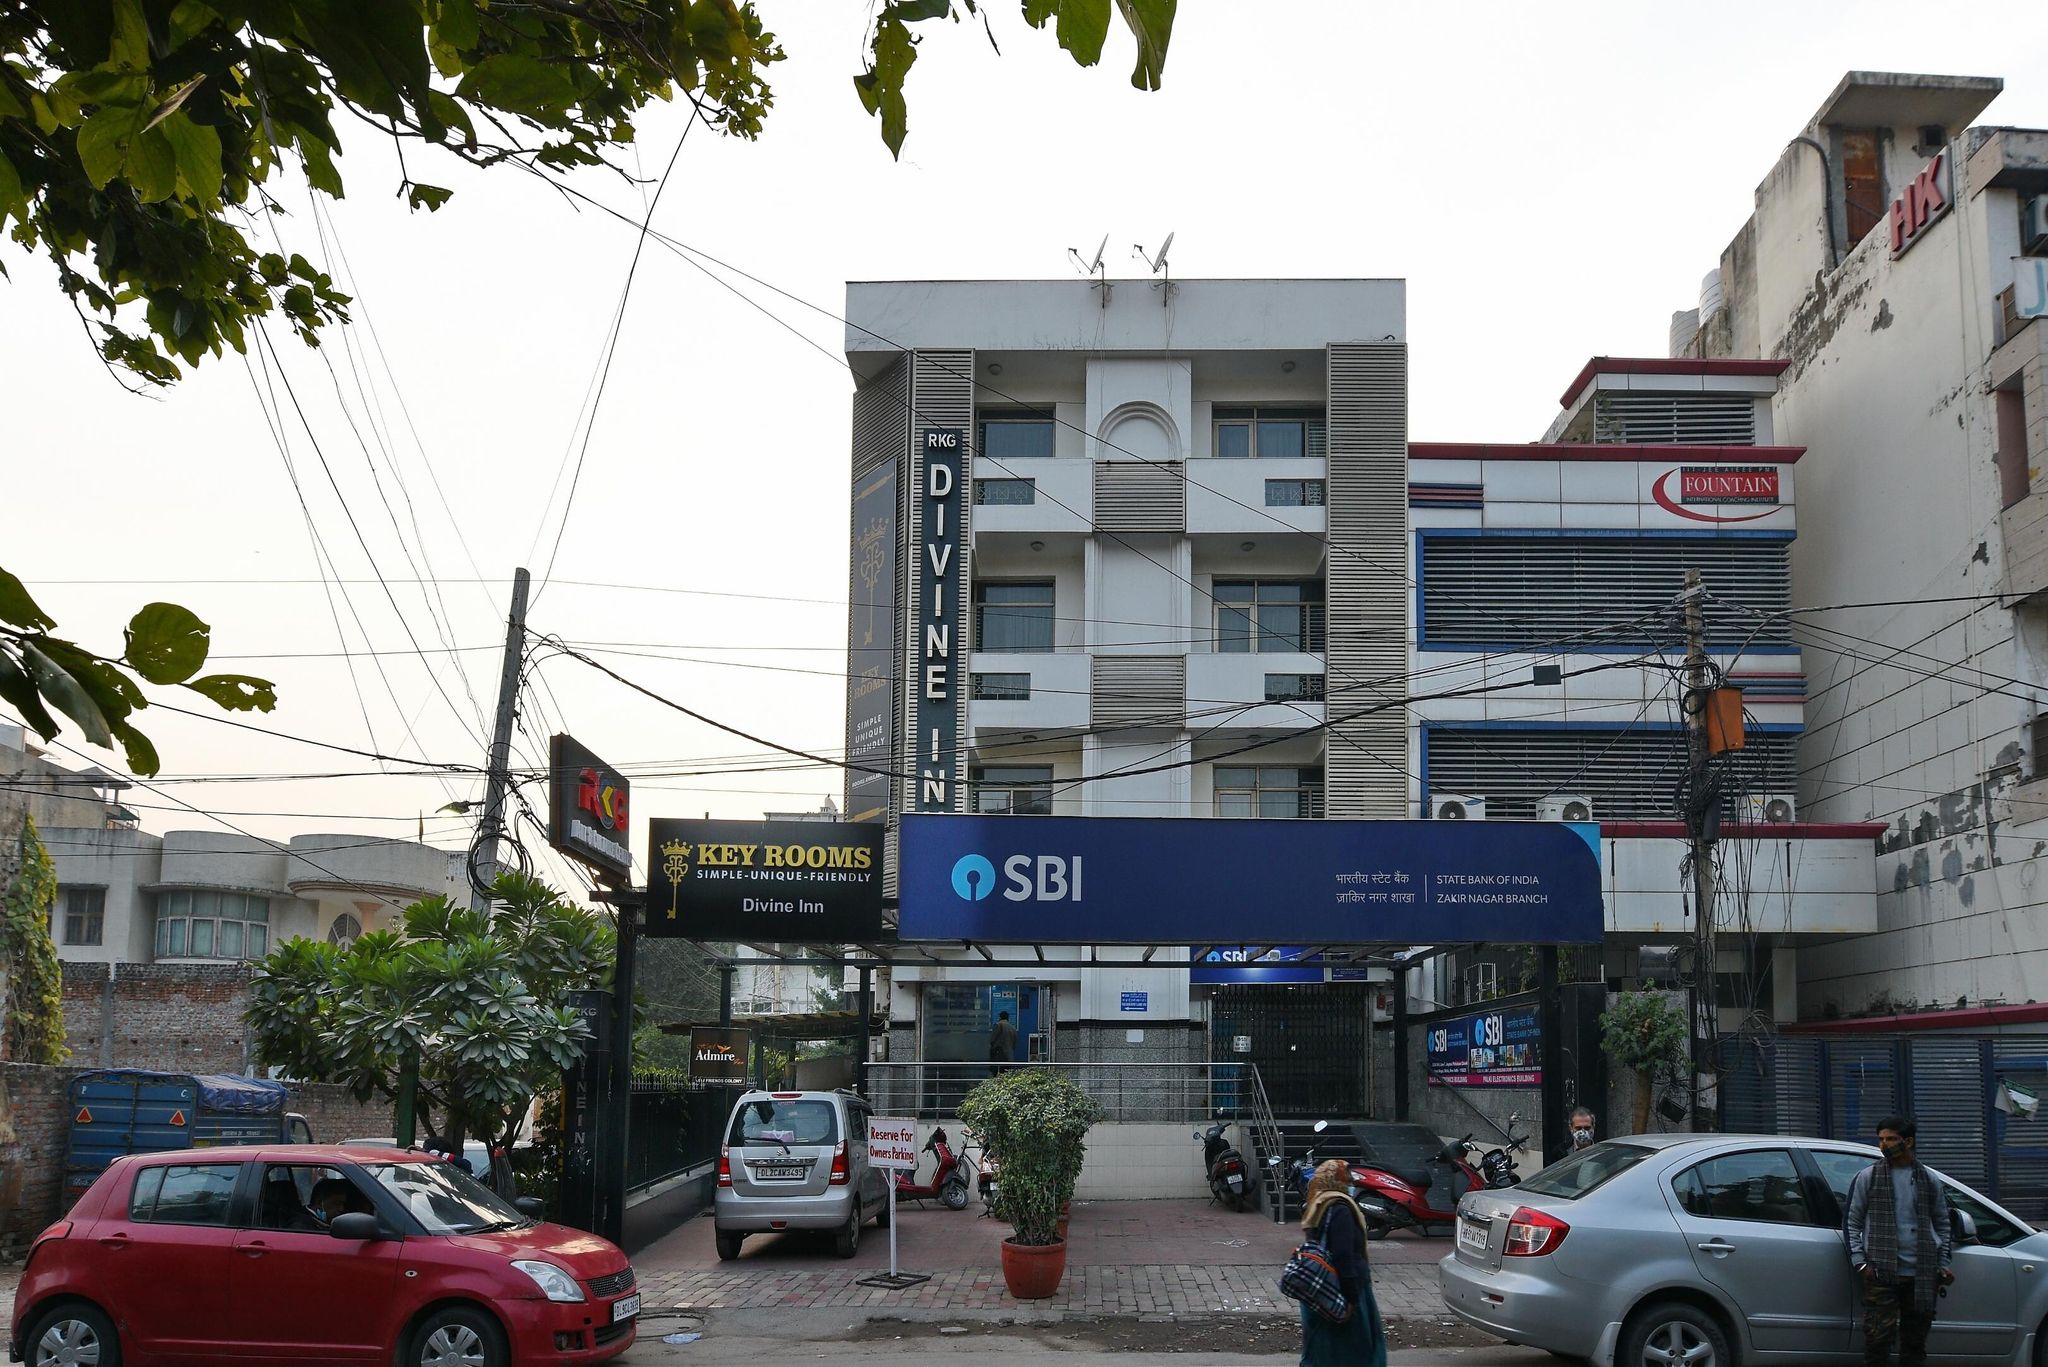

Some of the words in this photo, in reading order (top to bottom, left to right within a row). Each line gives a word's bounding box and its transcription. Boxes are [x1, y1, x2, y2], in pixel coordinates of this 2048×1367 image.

[1890, 154, 1945, 252] HK
[928, 433, 956, 448] RKG
[1686, 476, 1772, 493] FOUNTAIN
[926, 463, 953, 699] DIVINE
[857, 714, 882, 732] SIMPLE
[855, 725, 883, 744] UNIQUE
[852, 737, 886, 757] FRIENDLY
[923, 728, 945, 813] IN
[696, 843, 758, 866] KEY
[763, 844, 872, 869] ROOMS
[1003, 854, 1082, 902] SBI
[1335, 871, 1368, 884] भारतीय
[1371, 870, 1391, 884] स्टेट
[1436, 875, 1466, 885] STATE
[1468, 875, 1495, 885] BANK
[1496, 875, 1511, 885] OF
[1512, 875, 1540, 885] INDIA
[742, 898, 794, 913] Divine
[799, 899, 824, 913] Inn
[1369, 893, 1388, 904] नगर
[1390, 893, 1416, 904] शाखा
[1437, 894, 1467, 904] ZAKIR
[1468, 894, 1504, 904] NAGAR
[1505, 894, 1549, 904] BRANCH
[1485, 1014, 1503, 1046] SBI
[1434, 1029, 1447, 1052] SBI
[695, 1049, 735, 1061] Admire
[870, 1126, 899, 1141] Reserve
[900, 1128, 913, 1142] for
[870, 1145, 891, 1159] Owners
[891, 1146, 914, 1164] Parking
